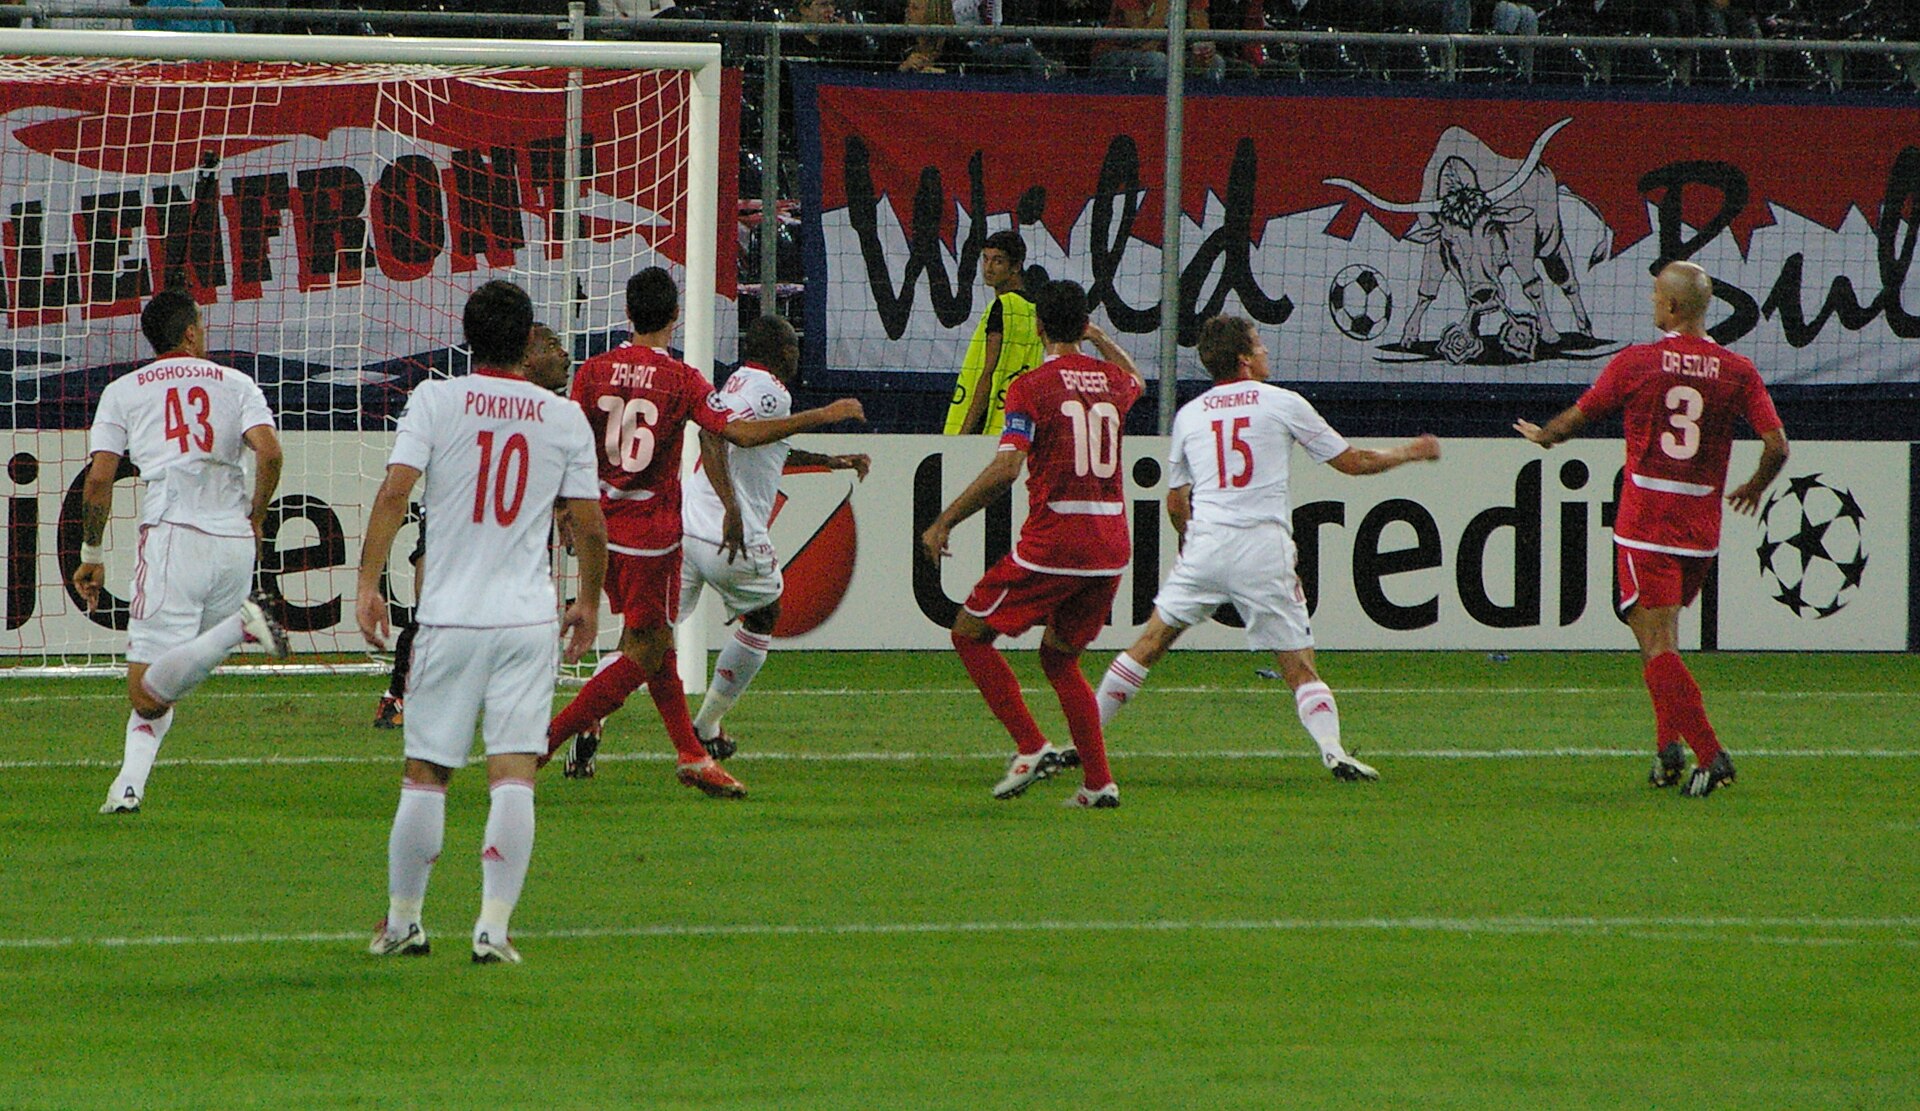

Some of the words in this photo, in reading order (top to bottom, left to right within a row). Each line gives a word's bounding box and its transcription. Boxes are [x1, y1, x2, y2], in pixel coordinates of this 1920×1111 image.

[137, 365, 223, 386] BOGHOSSIAN
[1203, 390, 1259, 411] SCHIEMER
[1682, 354, 1720, 379] SILVA
[165, 386, 214, 454] 43
[465, 391, 545, 433] POKRIVAC
[597, 395, 659, 473] 16
[1060, 400, 1120, 478] 10
[1661, 385, 1704, 459] 3
[473, 430, 529, 528] 10
[1211, 416, 1254, 489] 15
